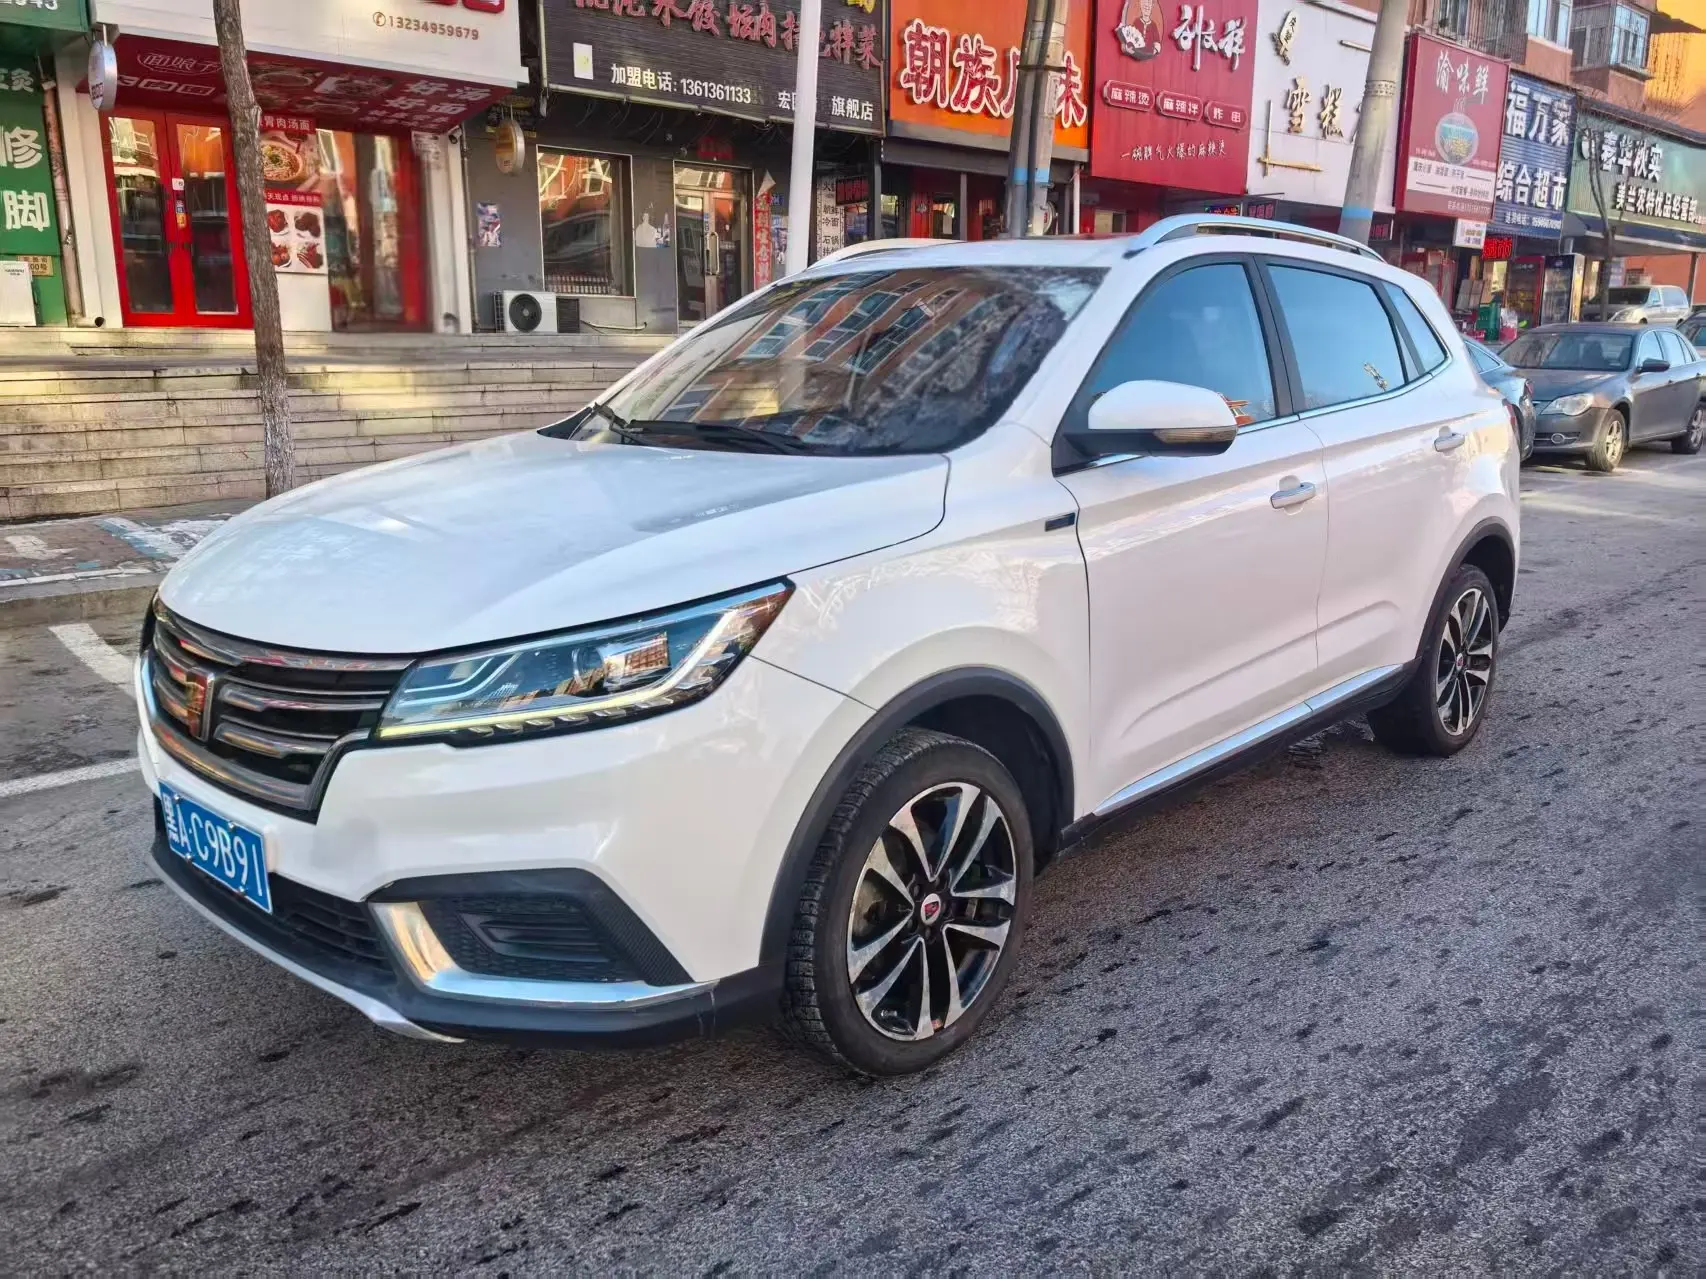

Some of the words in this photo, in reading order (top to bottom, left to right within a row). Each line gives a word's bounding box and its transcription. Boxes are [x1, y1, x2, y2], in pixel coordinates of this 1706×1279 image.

[388, 16, 479, 40] 13234959679
[1436, 50, 1489, 104] 渝味鲜
[831, 95, 873, 121] 旗舰店
[1111, 87, 1150, 106] 麻辣烫
[1163, 98, 1199, 115] 麻辣拌
[1507, 80, 1572, 146] 福万家
[1496, 159, 1567, 210] 综合超市
